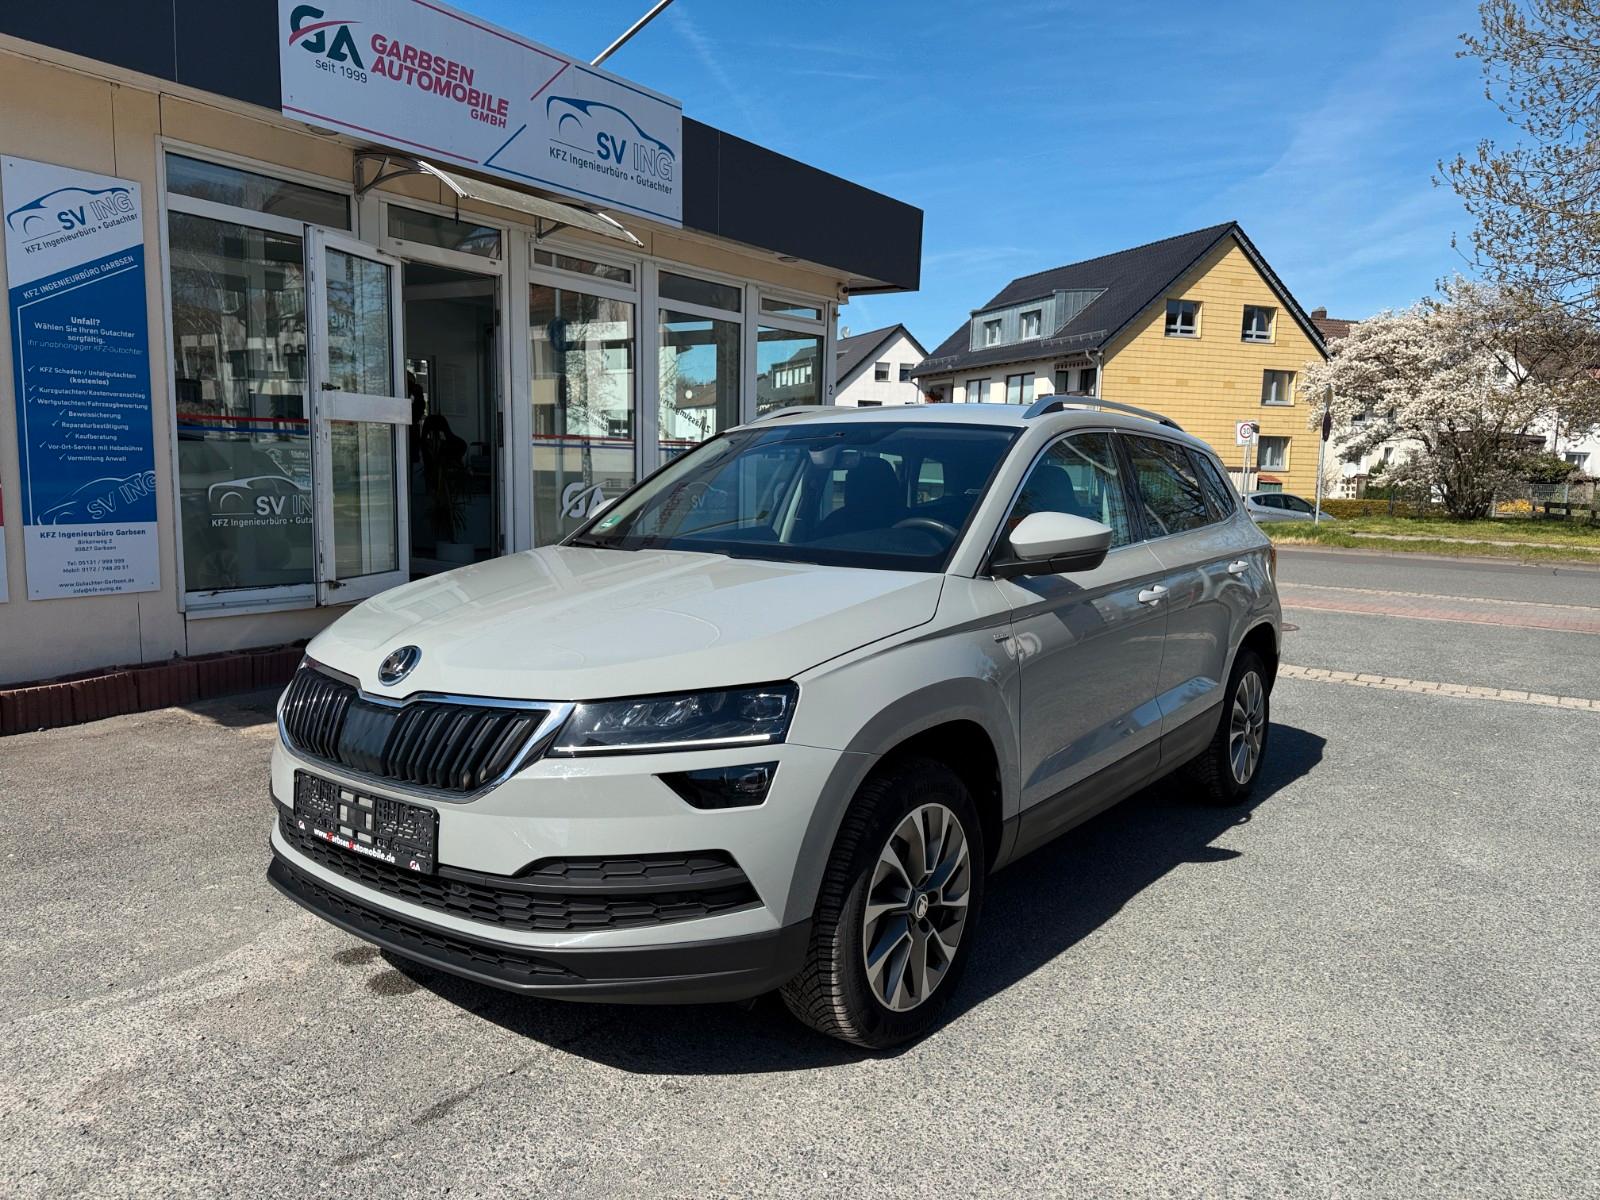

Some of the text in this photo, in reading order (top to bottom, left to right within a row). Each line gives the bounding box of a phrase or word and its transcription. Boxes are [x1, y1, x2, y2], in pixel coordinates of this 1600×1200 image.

[370, 33, 475, 86] GARBSEN
[315, 59, 368, 84] seit 1999
[370, 55, 510, 118] AUTOMOBILE
[470, 107, 507, 129] GMBH
[596, 131, 673, 182] SV ING
[549, 146, 673, 195] KFZ Ingenieurbüro Gutachter
[57, 190, 135, 231] SV ING
[25, 212, 139, 255] KFZ Ingenieurbüro Gutachter
[22, 255, 135, 301] KFZ INGENIEURBÜRO GARBSEN
[34, 321, 136, 339] Wählen Sie Ihren Gutachter
[70, 316, 101, 326] Unfall?
[40, 366, 54, 374] KFZ
[69, 376, 110, 386] (kostenlos)
[828, 384, 834, 396] 2
[75, 432, 118, 441] Kaufberatung
[1242, 427, 1251, 435] 30
[86, 490, 118, 520] SV
[256, 494, 313, 516] SV IN
[211, 518, 229, 527] KFZ
[230, 517, 288, 528] Ingenieurbüro
[39, 528, 146, 540] KFZ Ingenieurbüro Garbsen
